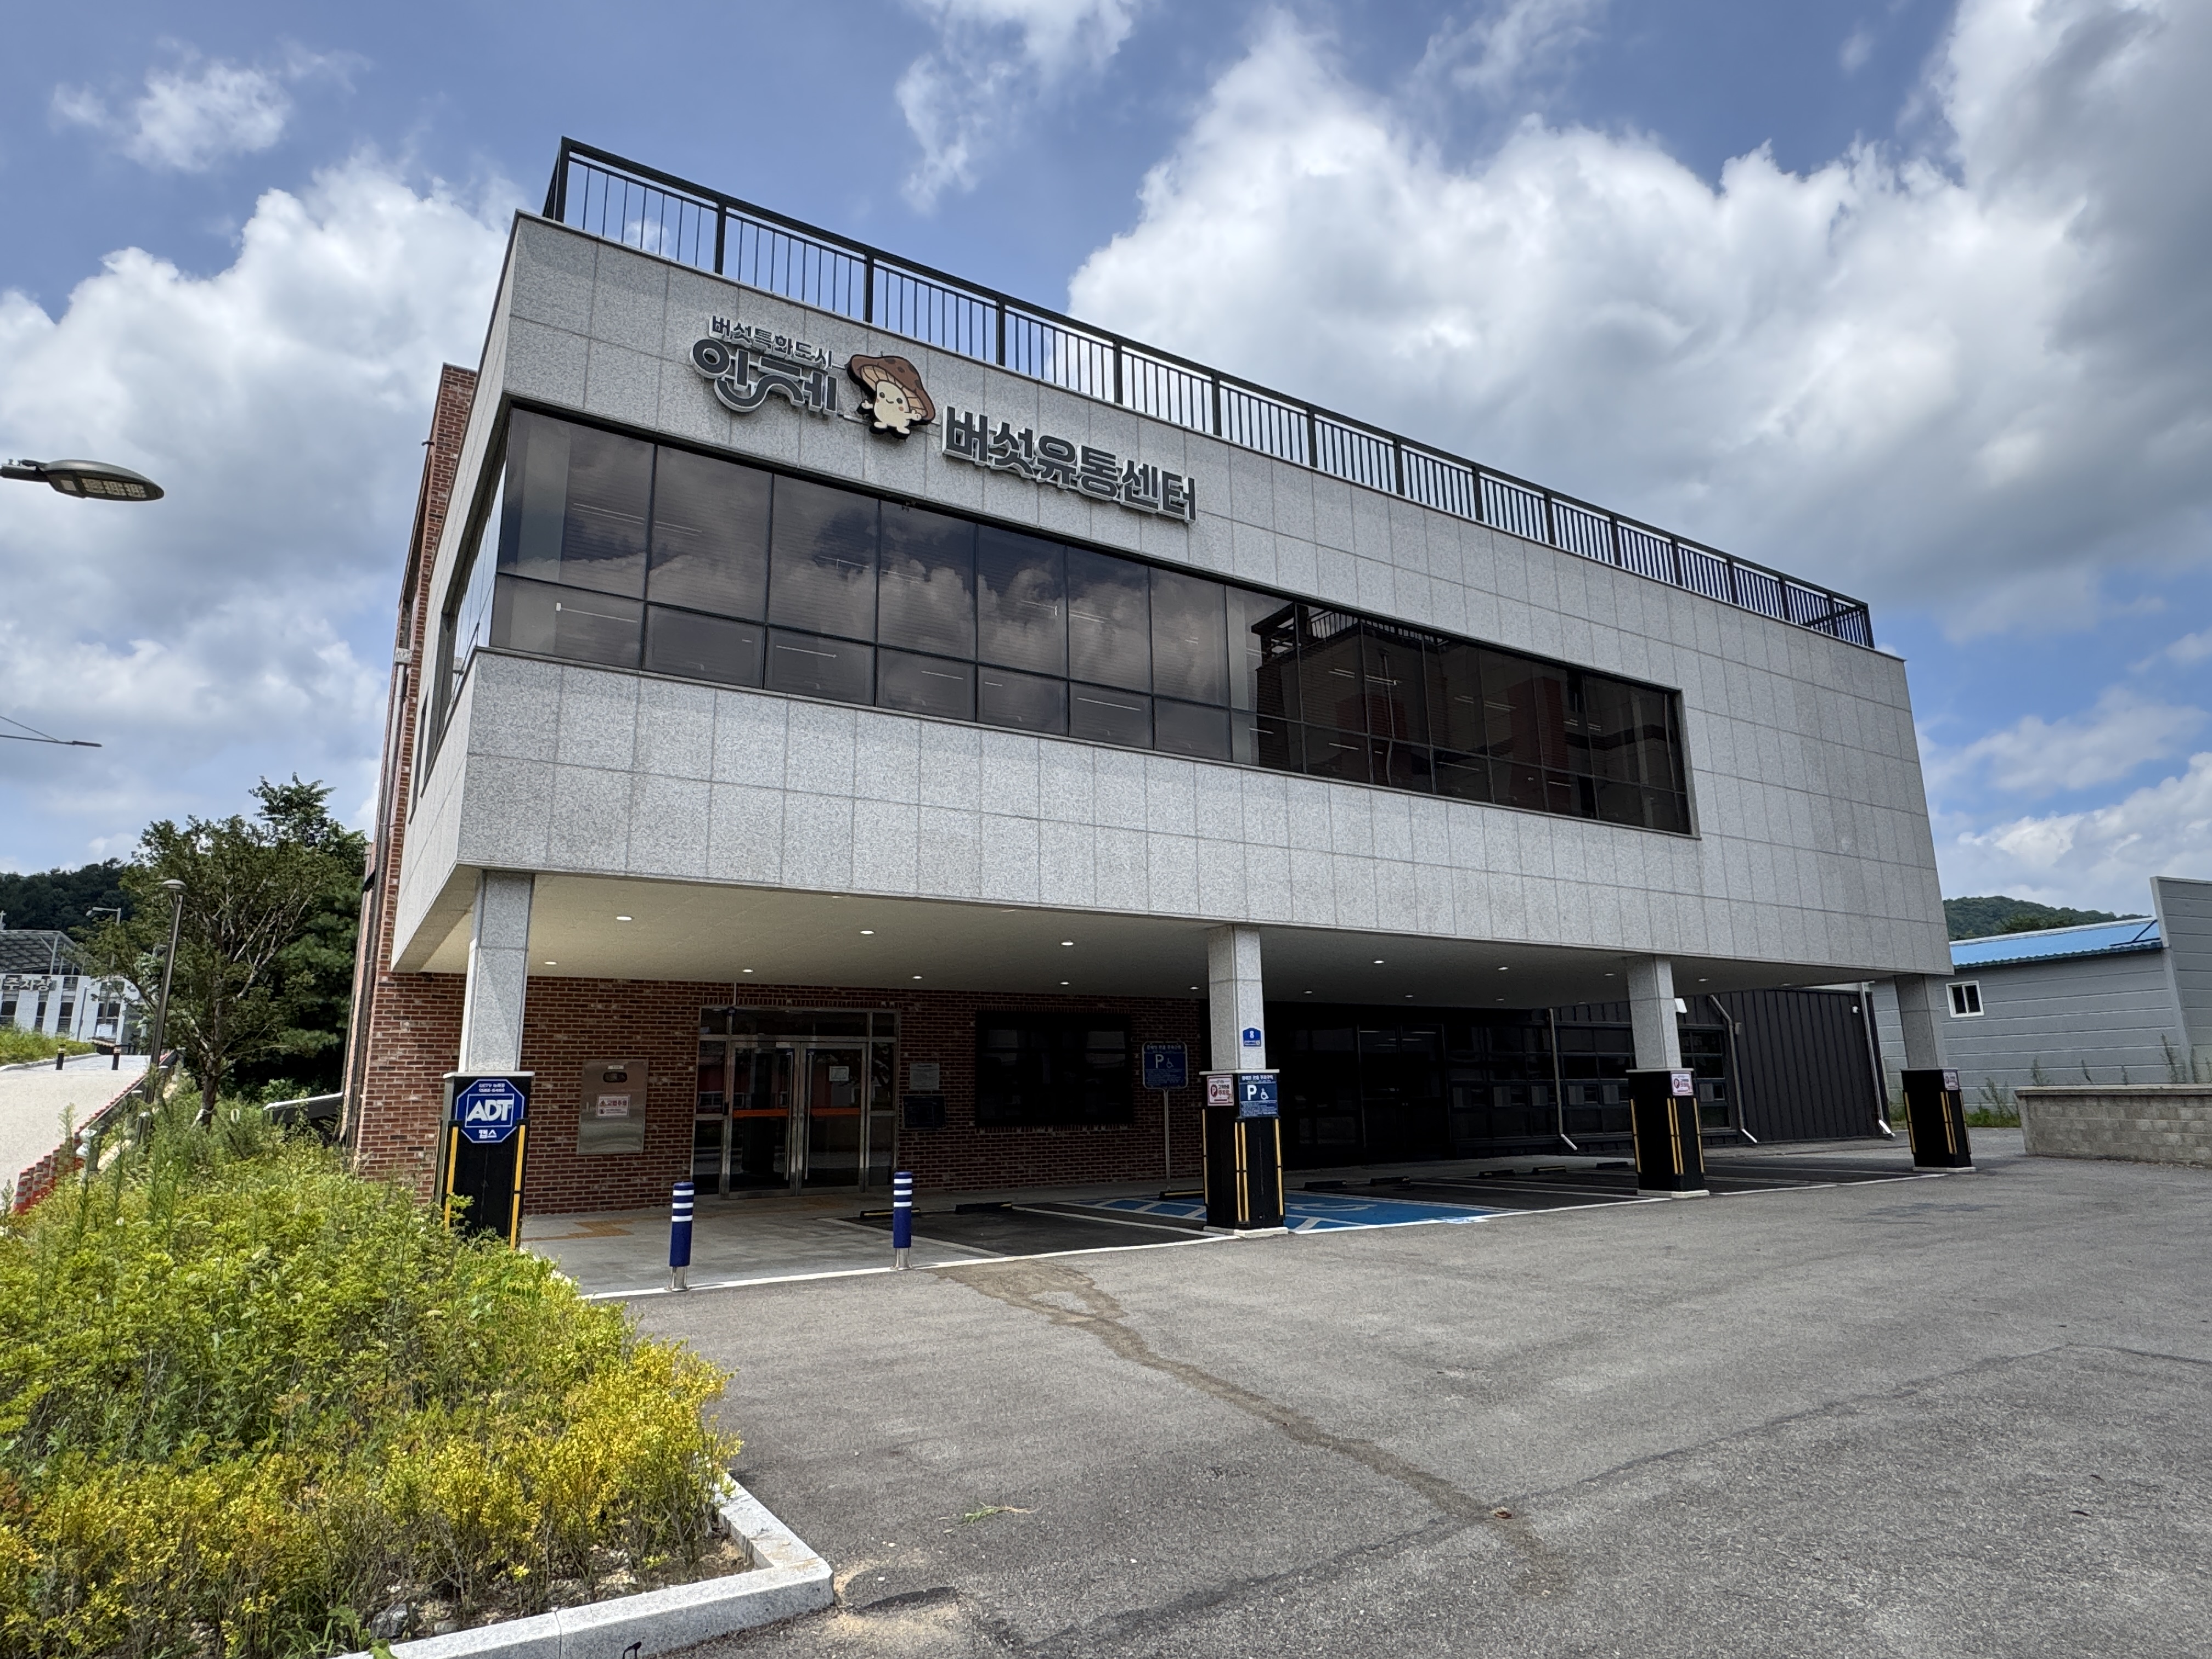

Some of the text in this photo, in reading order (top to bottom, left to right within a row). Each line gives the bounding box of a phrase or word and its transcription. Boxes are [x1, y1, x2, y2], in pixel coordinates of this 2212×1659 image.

[709, 315, 833, 370] 버섯특화도시
[942, 405, 1197, 523] 버섯유통센터
[1155, 1053, 1164, 1069] P
[1247, 1084, 1257, 1101] P
[466, 1099, 514, 1121] ADT
